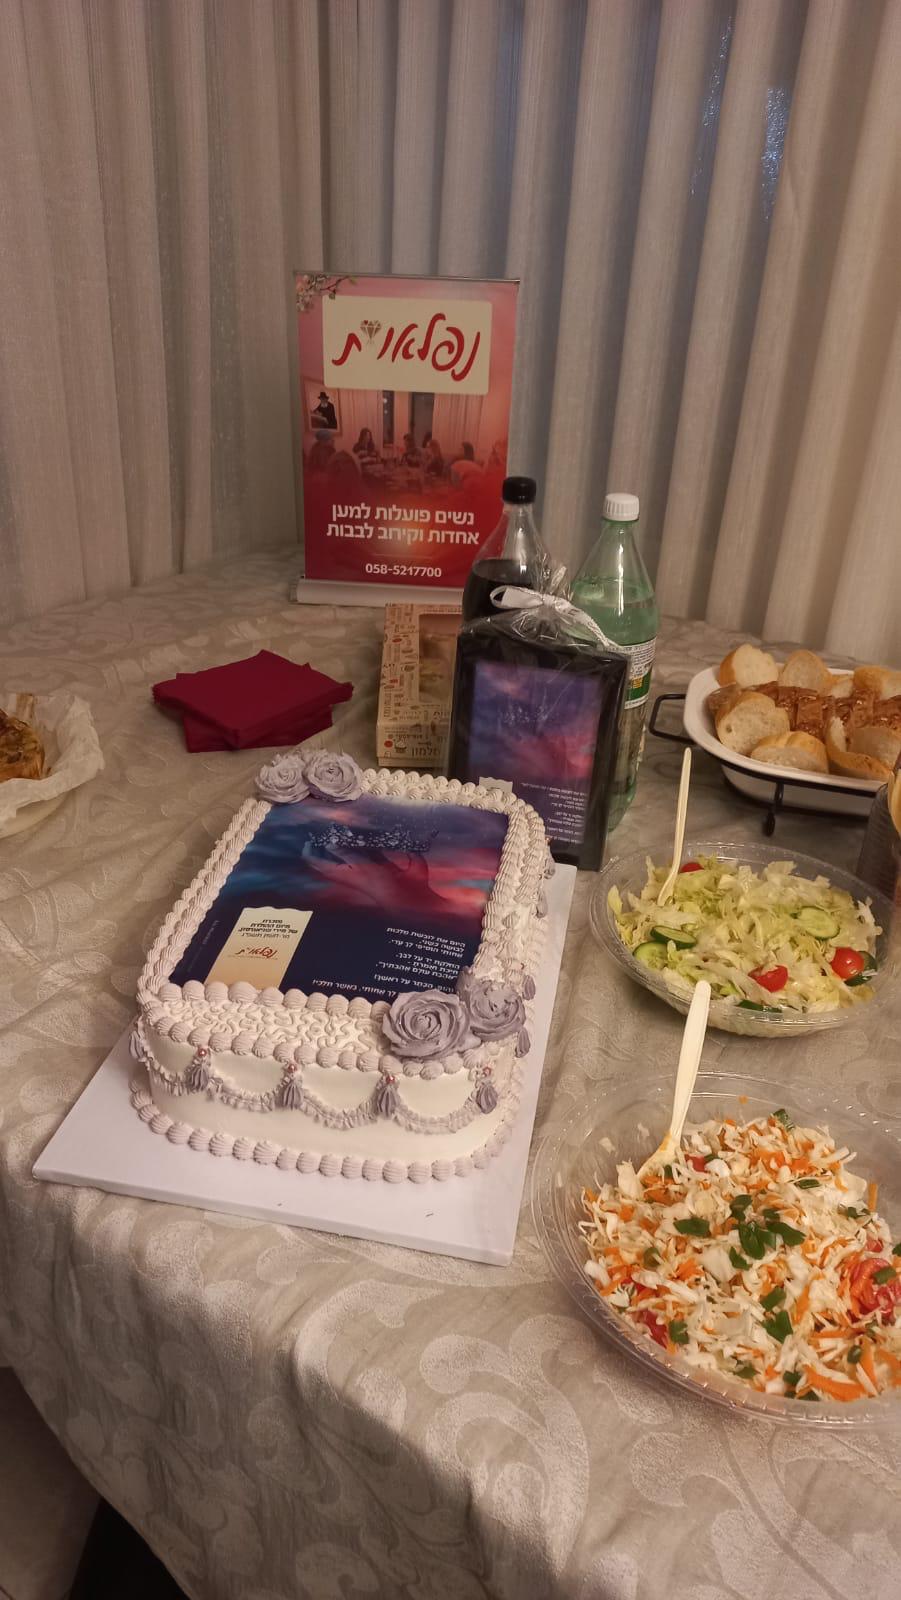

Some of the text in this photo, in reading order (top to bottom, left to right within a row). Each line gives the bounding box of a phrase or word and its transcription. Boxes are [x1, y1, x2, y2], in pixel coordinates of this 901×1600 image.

[332, 502, 475, 526] נשים פועלות למען
[326, 522, 480, 545] אחדות וקירוב לבבות
[365, 563, 442, 577] 058-5217700
[386, 927, 410, 935] מלכות
[410, 931, 436, 940] לובשת
[412, 967, 431, 975] עולם
